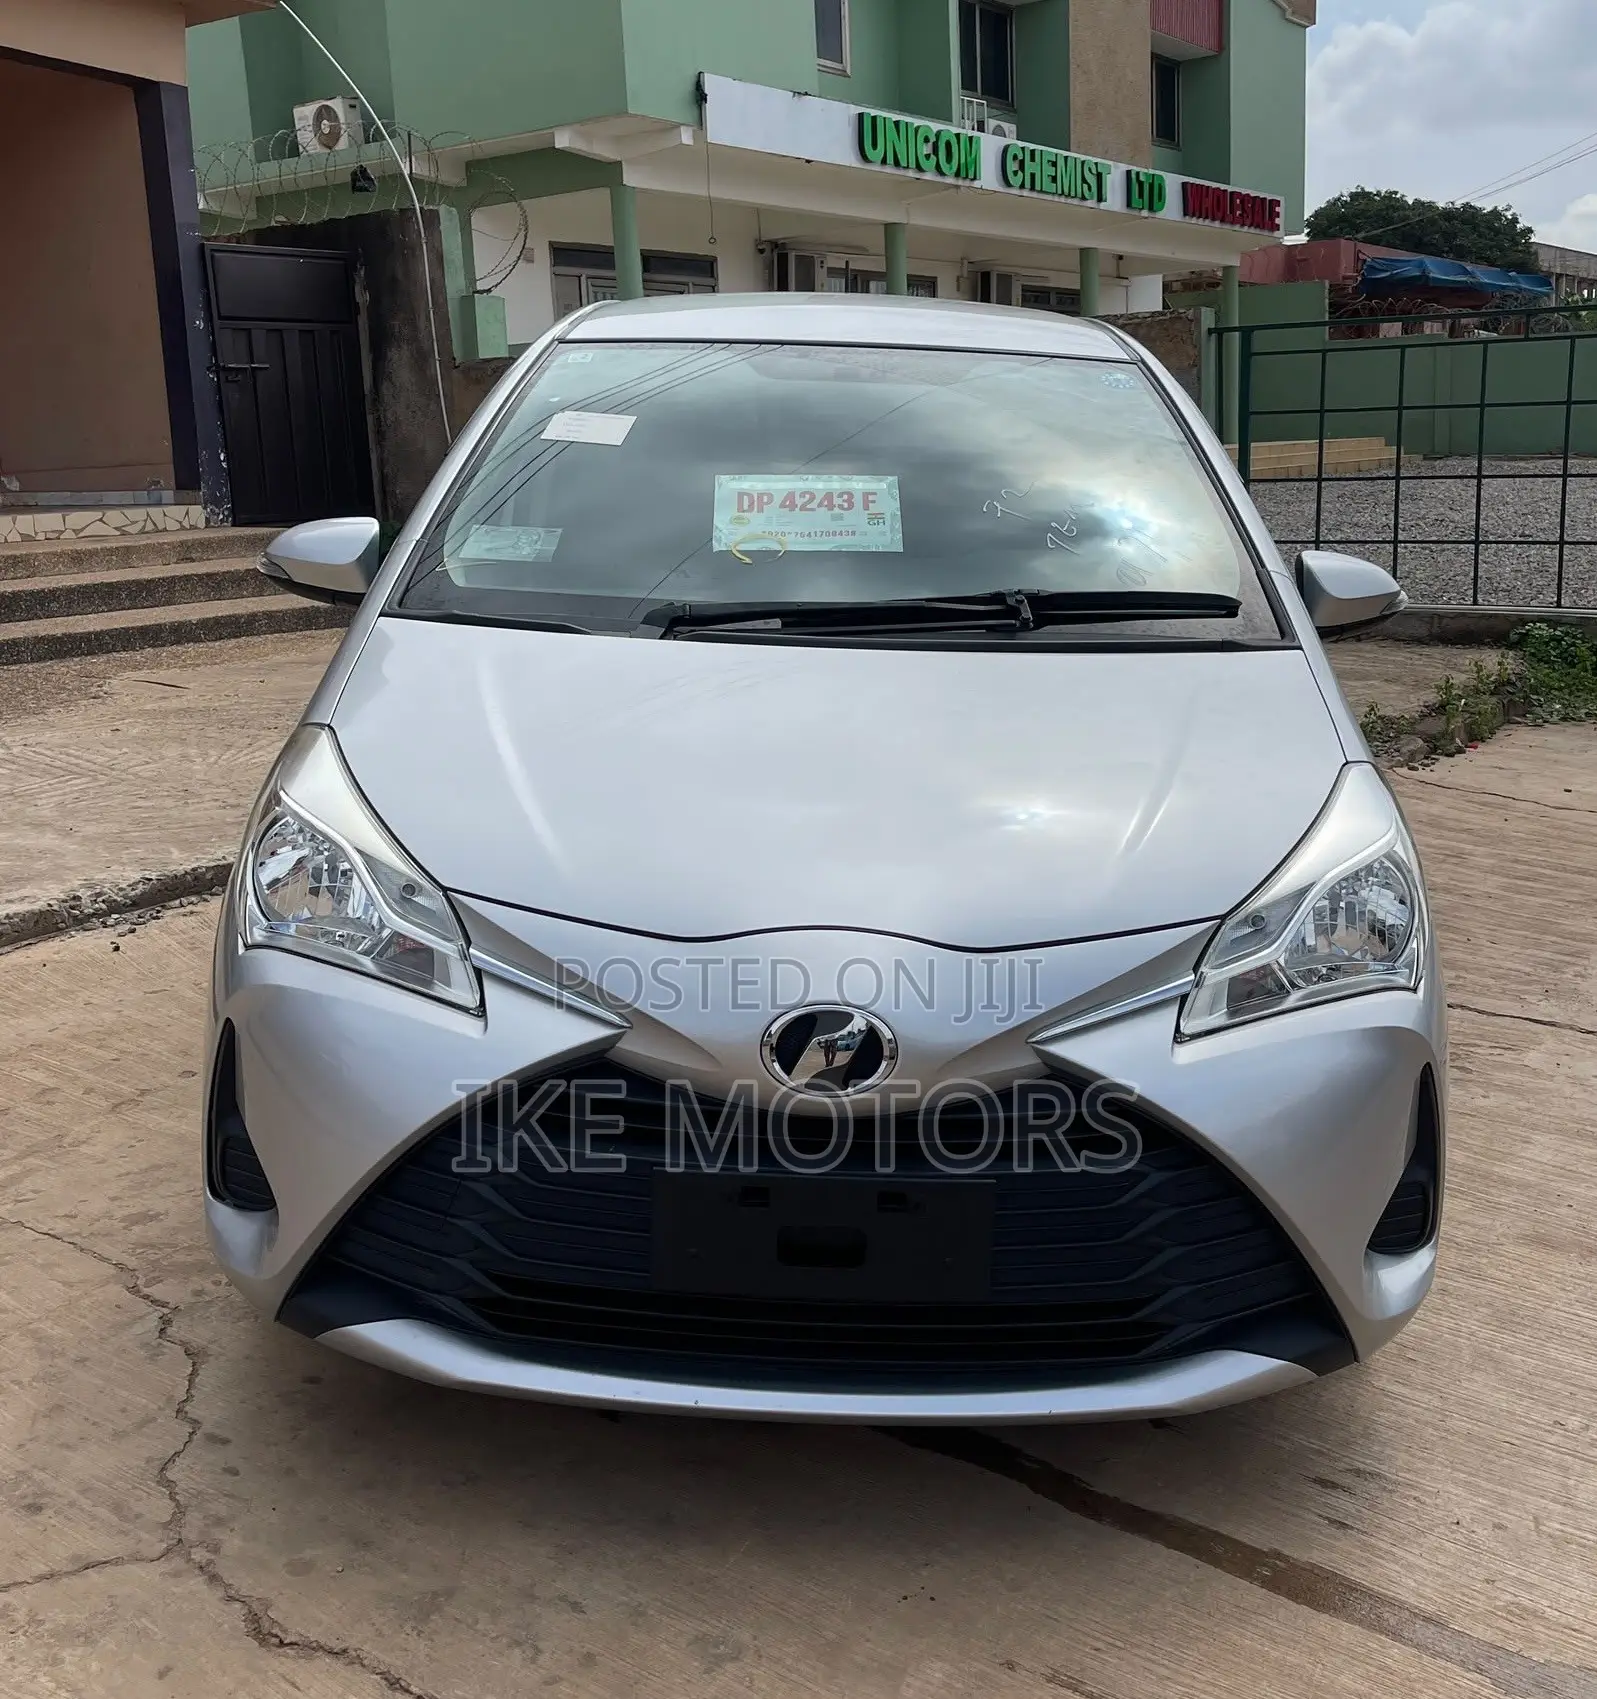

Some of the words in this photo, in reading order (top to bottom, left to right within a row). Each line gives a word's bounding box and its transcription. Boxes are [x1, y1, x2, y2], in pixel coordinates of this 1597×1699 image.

[858, 112, 981, 181] UNICOM
[1001, 143, 1112, 203] CHEMIST
[1126, 169, 1167, 213] LTD
[1181, 181, 1281, 233] WHOLESALE
[736, 491, 774, 513] DP
[778, 490, 855, 512] 4243
[861, 491, 878, 511] F
